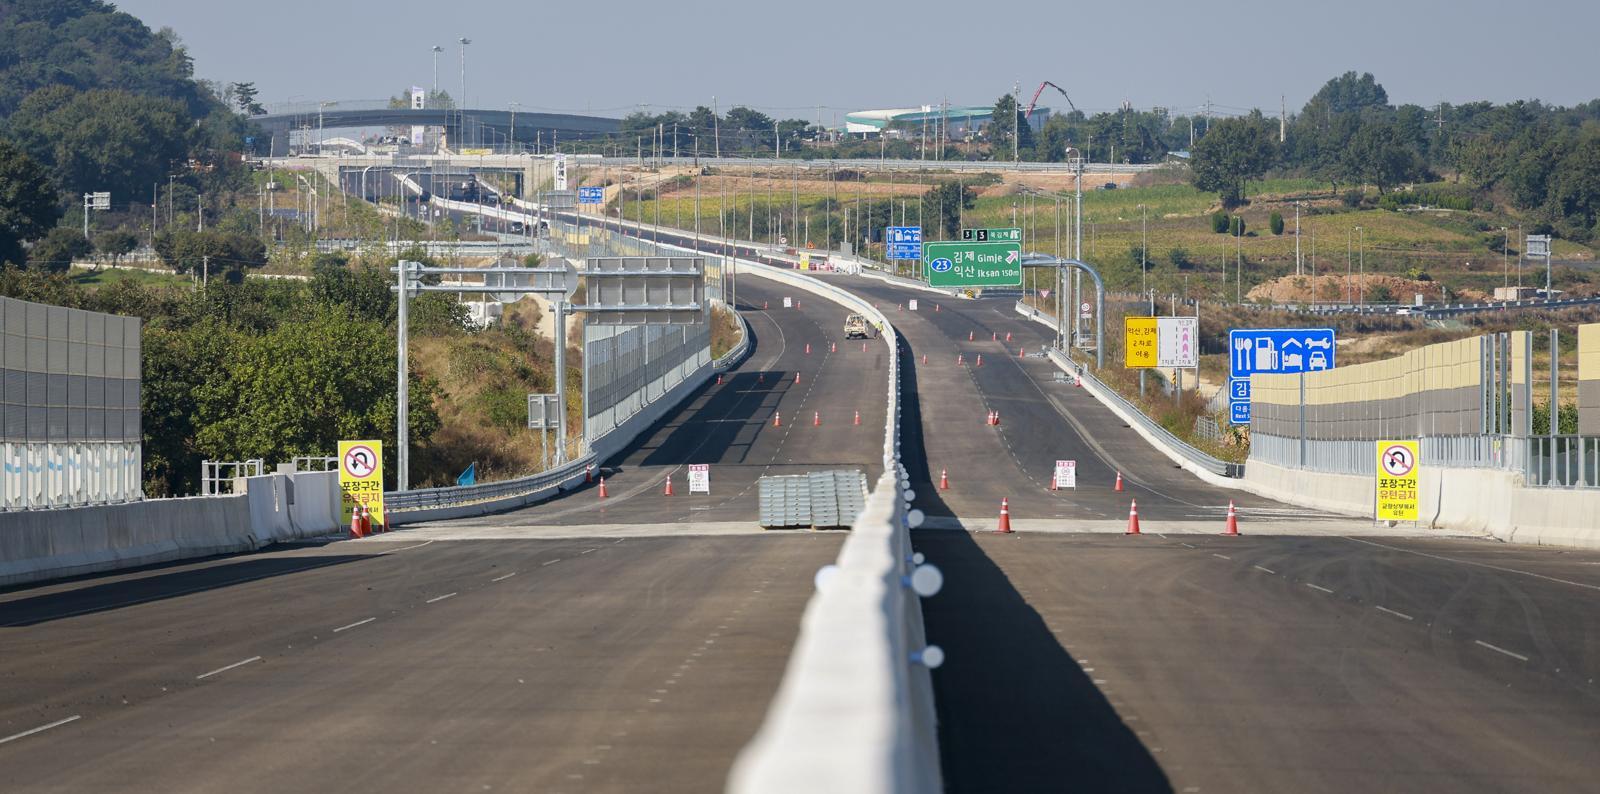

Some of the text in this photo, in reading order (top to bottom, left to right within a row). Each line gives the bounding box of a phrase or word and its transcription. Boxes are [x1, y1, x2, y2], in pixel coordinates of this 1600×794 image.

[953, 251, 1003, 264] 김제 Gimje
[936, 260, 948, 270] 23
[954, 265, 1020, 278] 익산 Iksan 150m
[1236, 382, 1250, 396] 김
[342, 480, 380, 491] 포장구간
[1380, 478, 1416, 489] 포장구간
[342, 492, 380, 503] 유턴금지
[1380, 490, 1416, 500] 유턴금지
